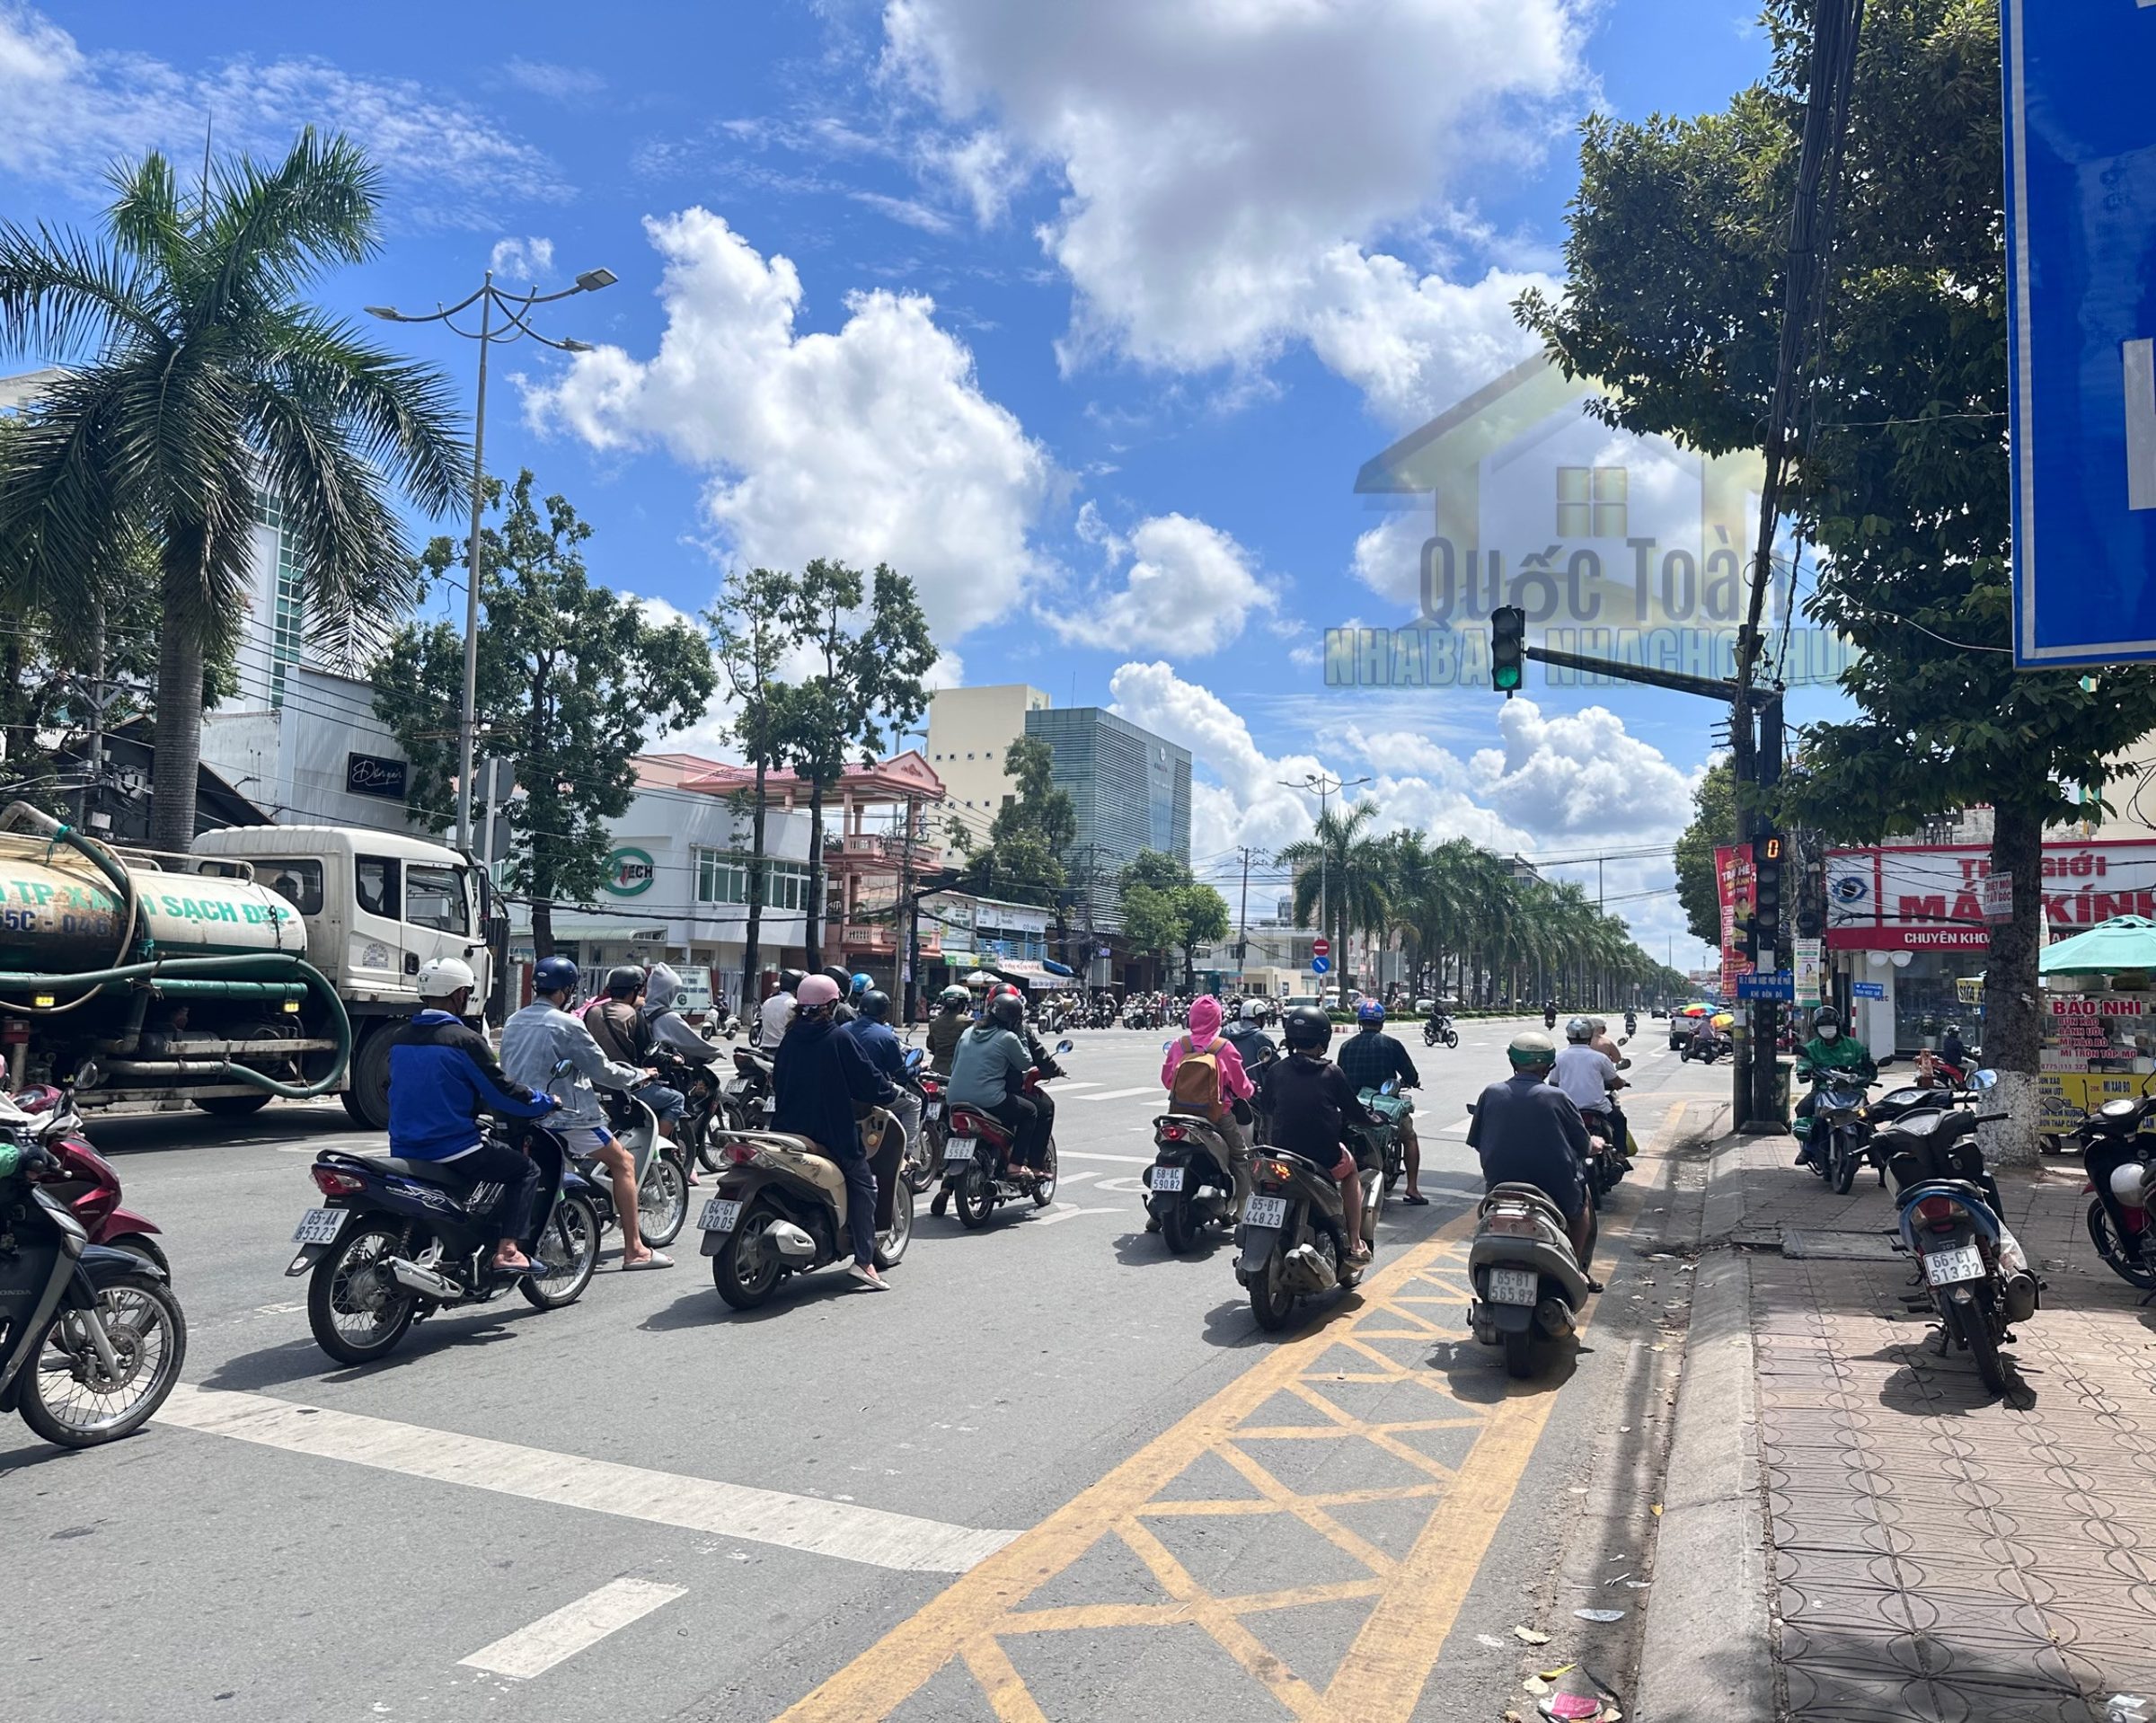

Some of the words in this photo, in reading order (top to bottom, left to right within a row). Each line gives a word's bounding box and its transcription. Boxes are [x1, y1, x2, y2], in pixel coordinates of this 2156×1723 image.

[1767, 839, 1779, 859] 0
[10, 880, 55, 906] TP
[165, 897, 239, 924] SẠCH
[0, 909, 36, 931] 5C
[1904, 931, 1957, 944] CHUYÊN
[2102, 1000, 2143, 1016] NHI
[1245, 1212, 1281, 1226] 448.23
[1931, 1263, 1982, 1283] 513.32
